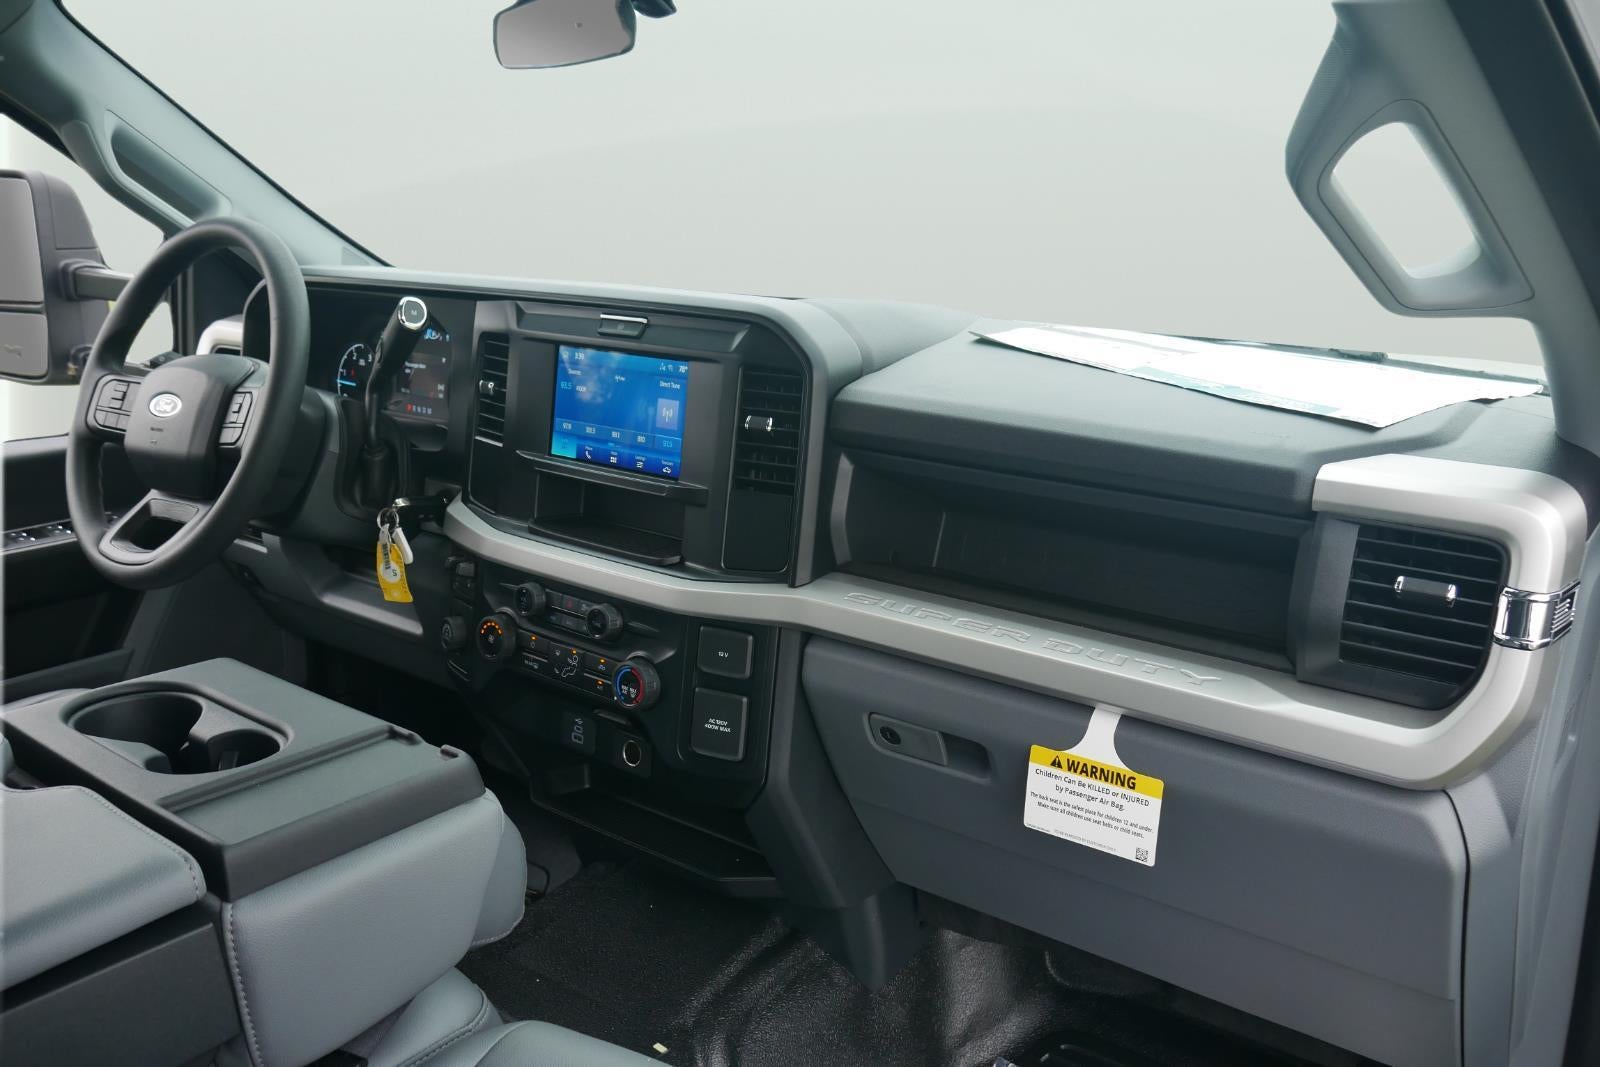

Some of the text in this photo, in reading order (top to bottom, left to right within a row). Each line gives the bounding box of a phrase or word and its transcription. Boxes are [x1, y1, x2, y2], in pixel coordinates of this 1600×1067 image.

[843, 592, 1222, 686] SUPER DUTY
[1035, 768, 1062, 781] Children
[1064, 776, 1076, 786] Can
[1077, 780, 1086, 788] Be
[1088, 783, 1110, 796] KILLED
[1120, 792, 1150, 807] INJURED
[1066, 758, 1136, 790] WARNING
[1055, 784, 1064, 793] by
[1065, 788, 1098, 804] Passenger
[1100, 796, 1109, 806] Air
[1066, 810, 1083, 820] children
[1102, 820, 1113, 828] belts
[1084, 808, 1096, 816] place
[1104, 813, 1122, 824] children
